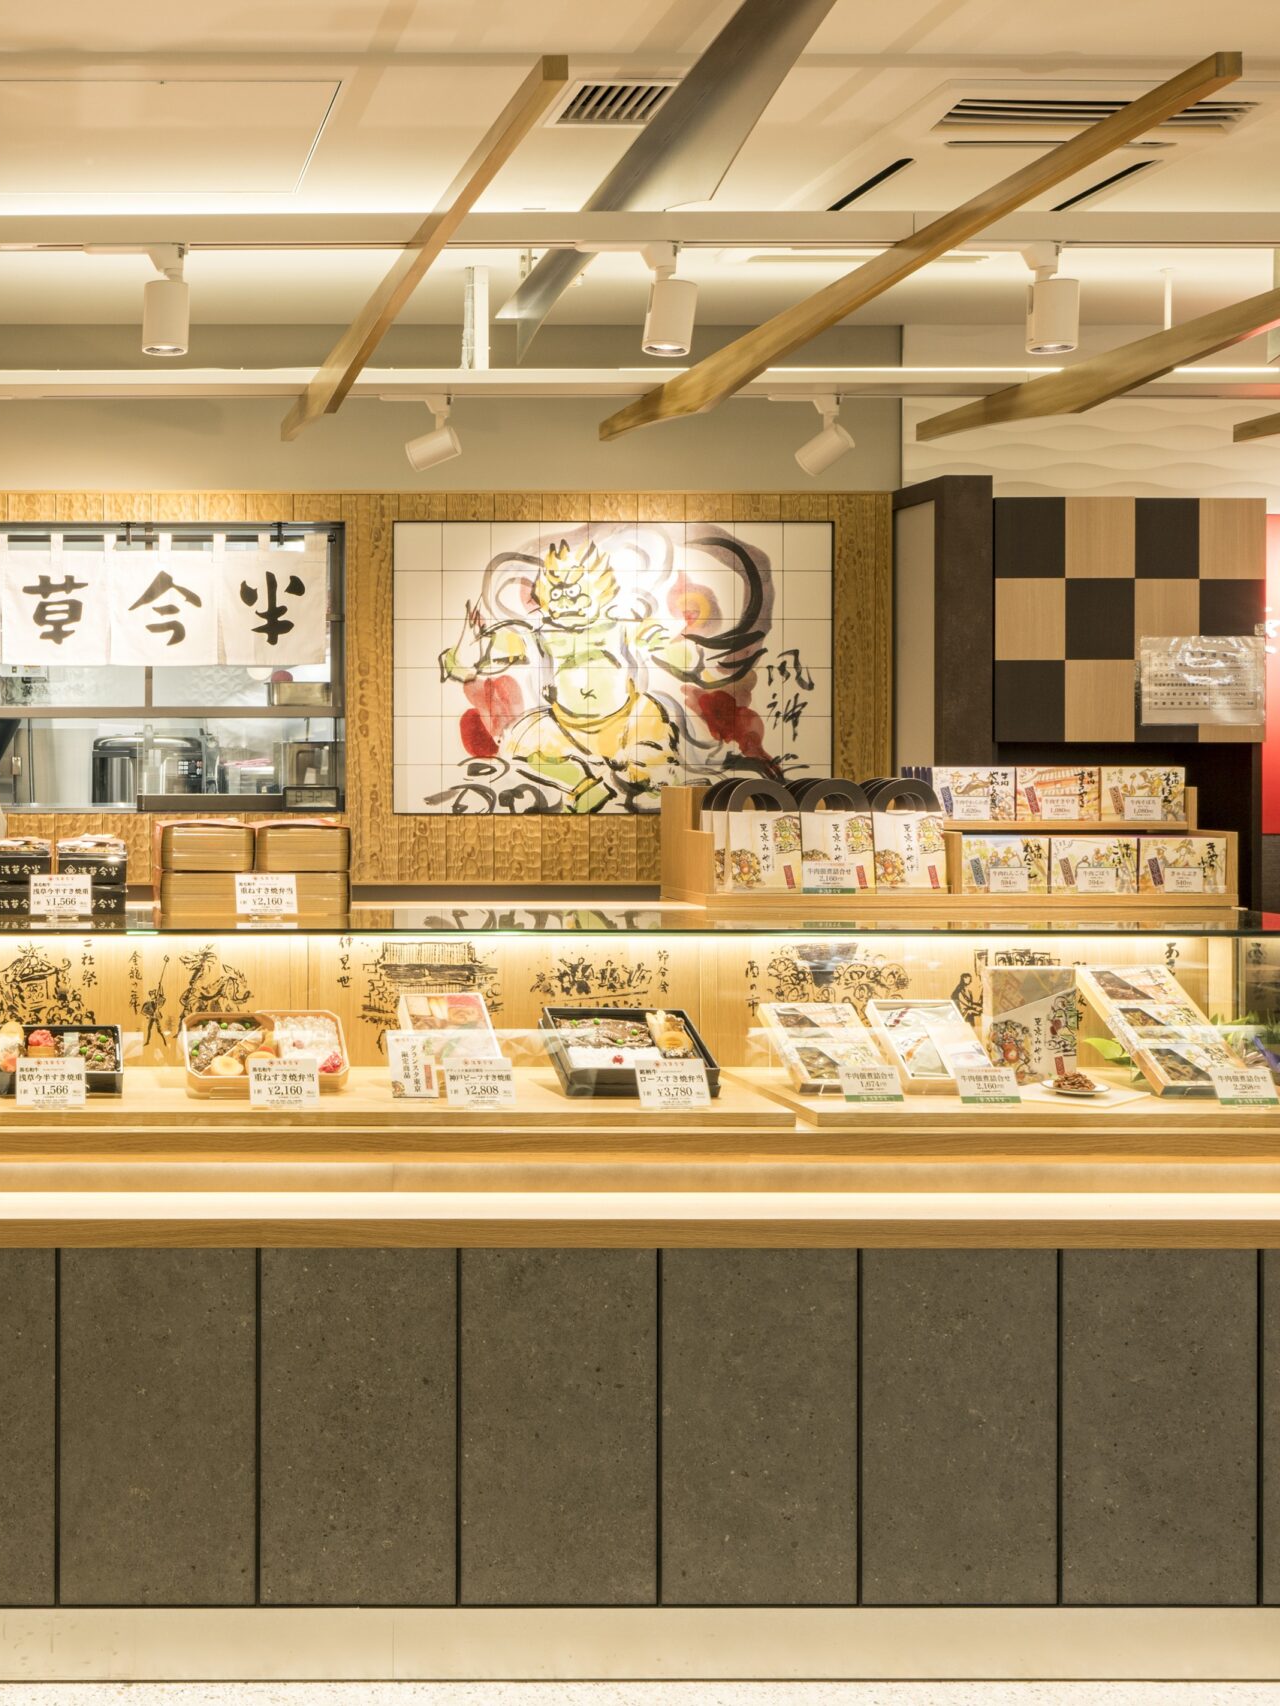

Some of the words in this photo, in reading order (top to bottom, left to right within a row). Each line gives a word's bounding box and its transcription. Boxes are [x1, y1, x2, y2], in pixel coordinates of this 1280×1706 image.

[831, 823, 842, 862] 東京みや
[34, 1085, 69, 1095] ¥1,566
[268, 1085, 303, 1095] ¥2,160
[465, 1085, 499, 1096] ¥2,808
[657, 1087, 693, 1097] ¥3,780
